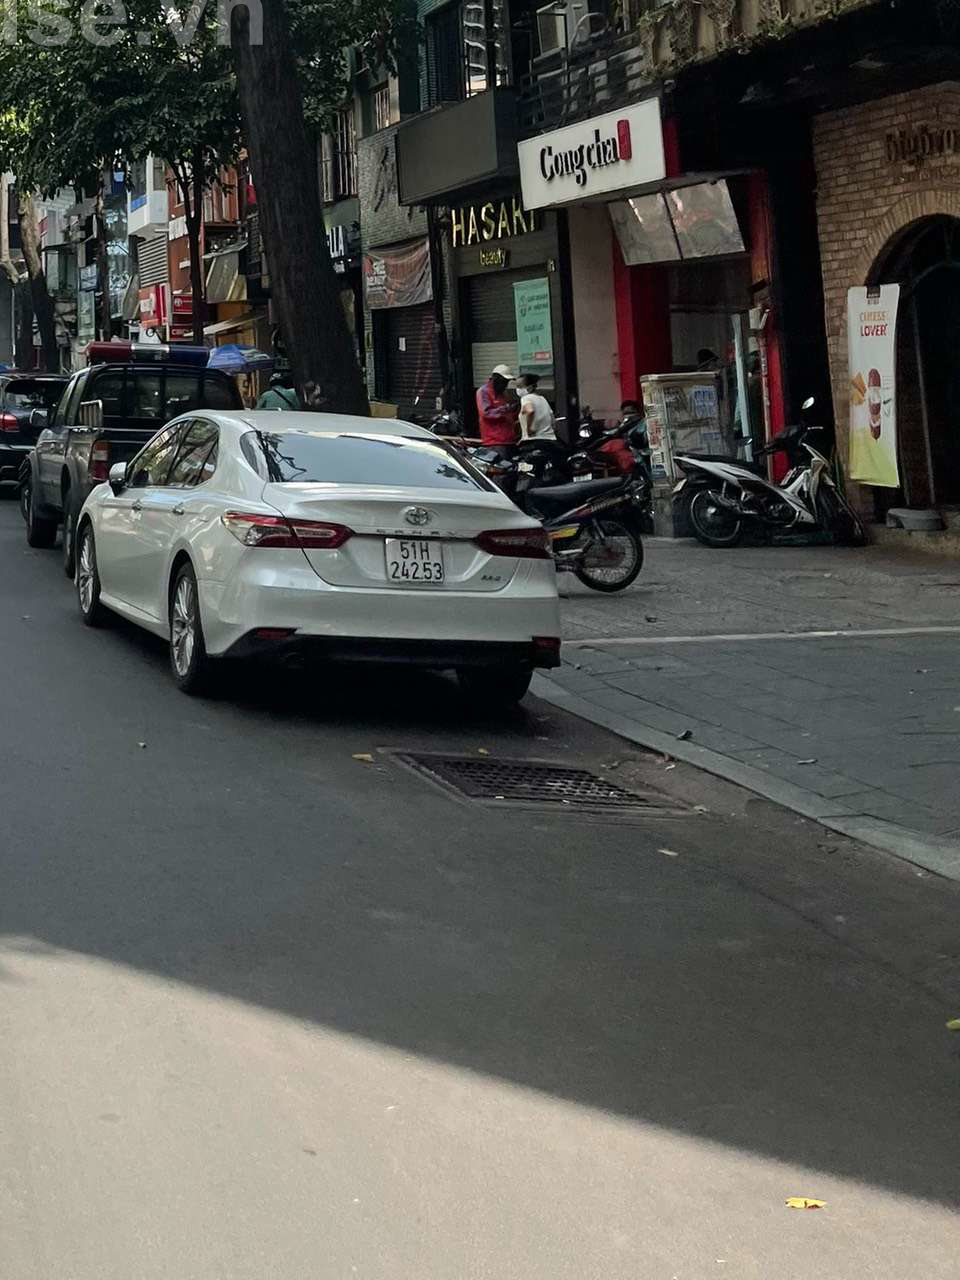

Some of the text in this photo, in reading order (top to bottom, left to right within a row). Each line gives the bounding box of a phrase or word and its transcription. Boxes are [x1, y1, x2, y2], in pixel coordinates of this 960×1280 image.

[451, 196, 535, 248] HASAKI
[860, 324, 888, 337] LOVER
[400, 541, 430, 561] 51H
[390, 561, 443, 580] 24253
